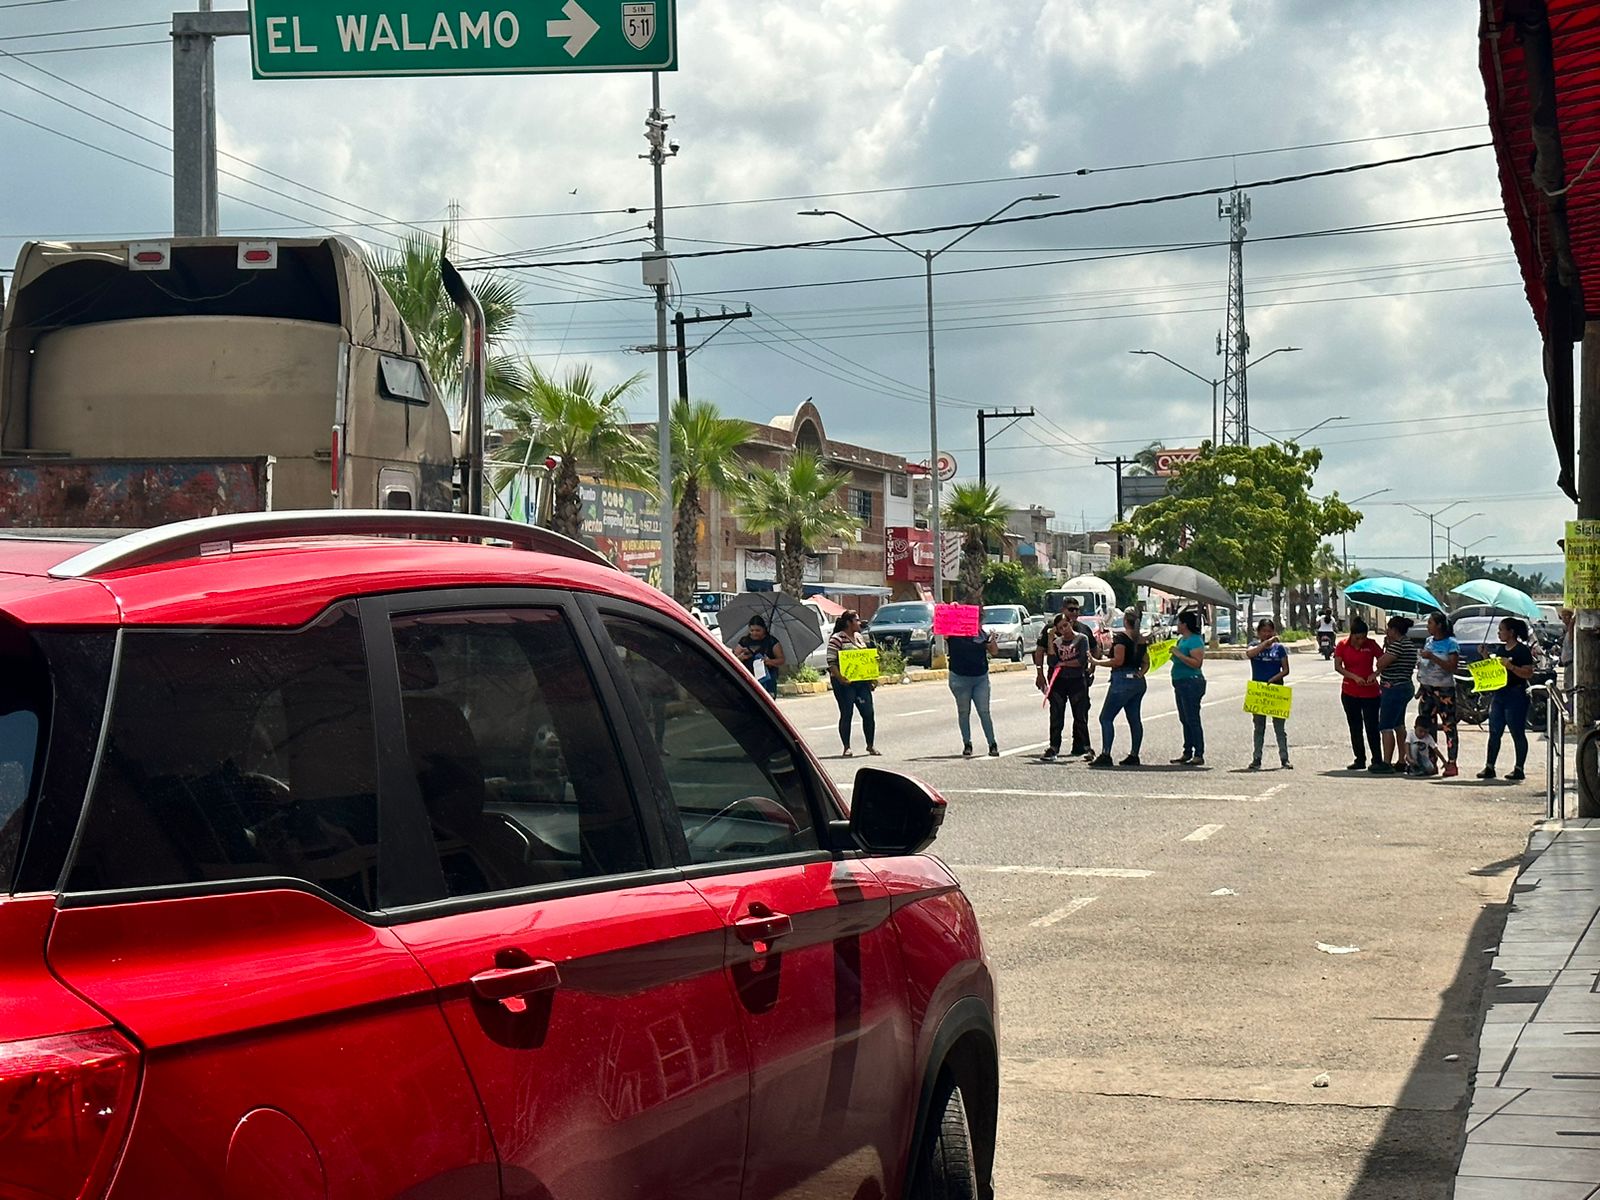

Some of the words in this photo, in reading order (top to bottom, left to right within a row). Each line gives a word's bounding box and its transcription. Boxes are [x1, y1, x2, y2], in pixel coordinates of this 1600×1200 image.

[266, 16, 318, 54] EL
[336, 10, 520, 52] WALAMO
[579, 486, 596, 501] Punto
[887, 528, 895, 576] PINTURAS
